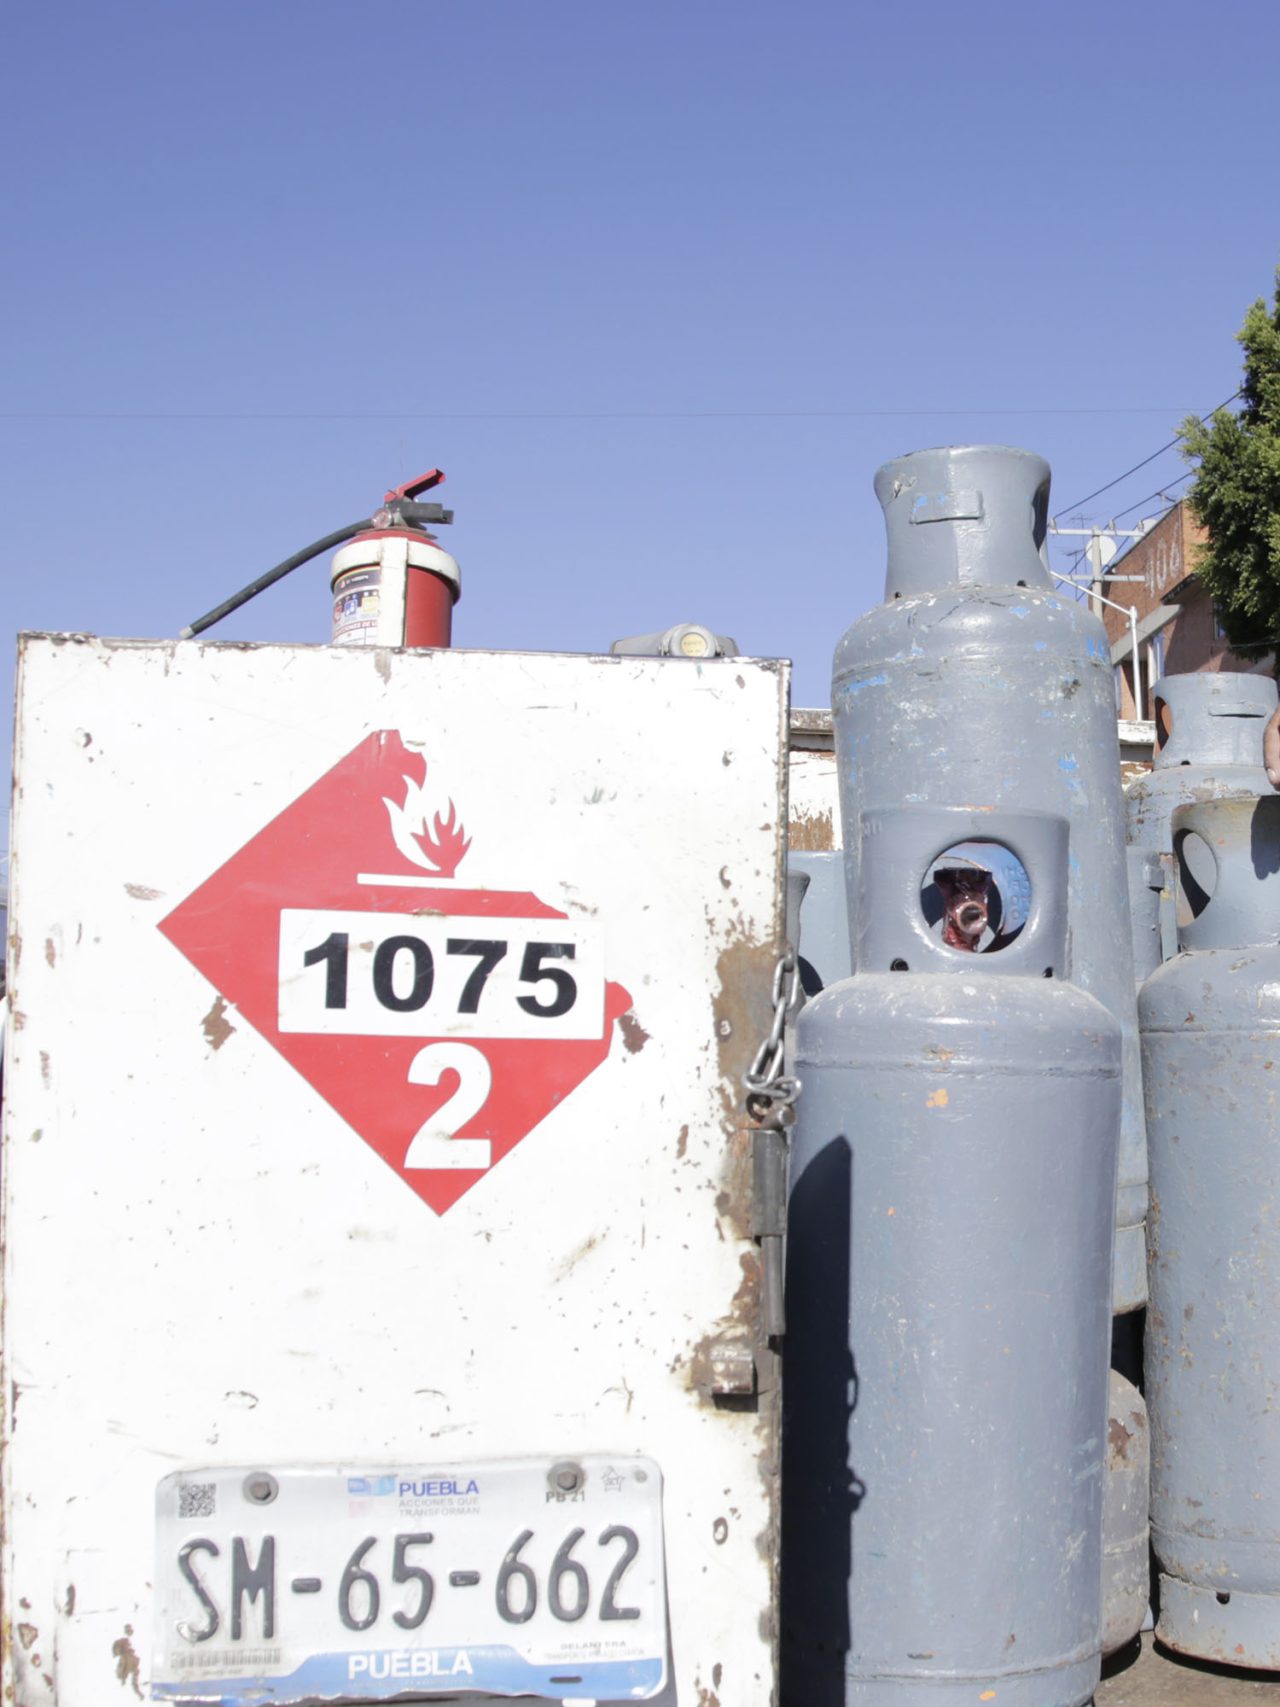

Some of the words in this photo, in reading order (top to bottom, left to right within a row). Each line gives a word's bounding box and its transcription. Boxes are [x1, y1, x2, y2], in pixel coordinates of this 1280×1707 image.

[304, 932, 578, 1018] 1075
[404, 1041, 493, 1169] 2
[399, 1480, 480, 1497] PUEBLA
[546, 1491, 566, 1503] PB
[571, 1490, 585, 1502] 21
[399, 1497, 454, 1508] ACCIONES
[456, 1496, 479, 1506] QUE
[400, 1507, 480, 1517] TRANSFORMAN
[175, 1525, 641, 1643] SM-65-662
[348, 1650, 474, 1680] PUEBLA
